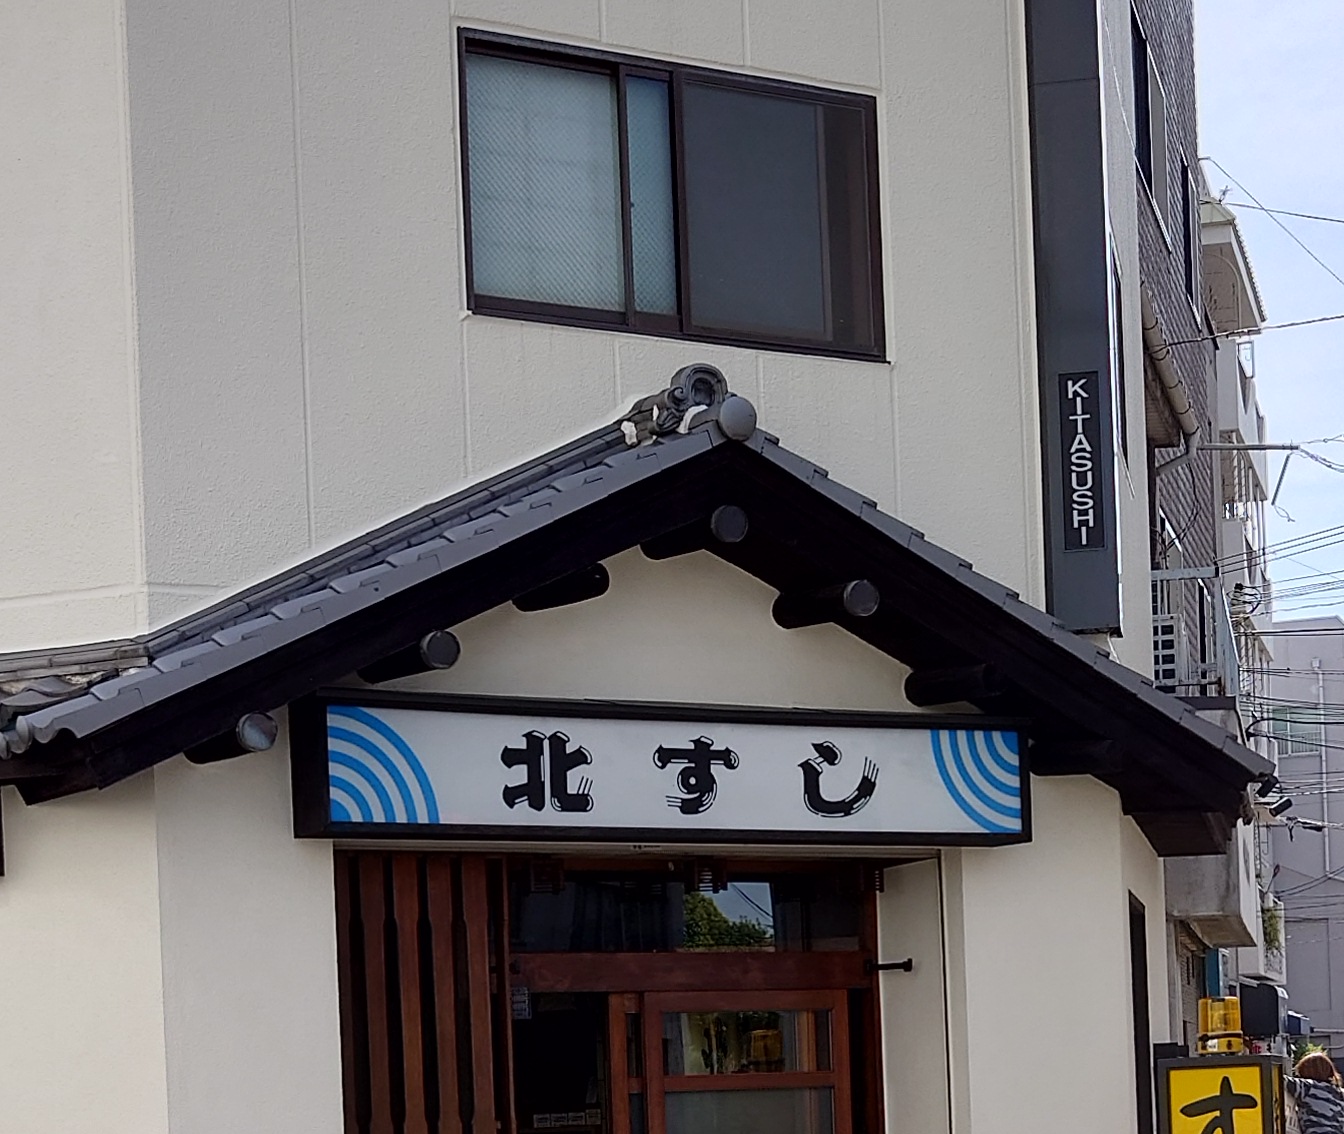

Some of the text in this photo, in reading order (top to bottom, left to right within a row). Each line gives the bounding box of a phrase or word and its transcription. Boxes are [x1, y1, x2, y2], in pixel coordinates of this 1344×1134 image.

[1067, 378, 1094, 545] KITASUSHI
[500, 730, 880, 818] 北すし
